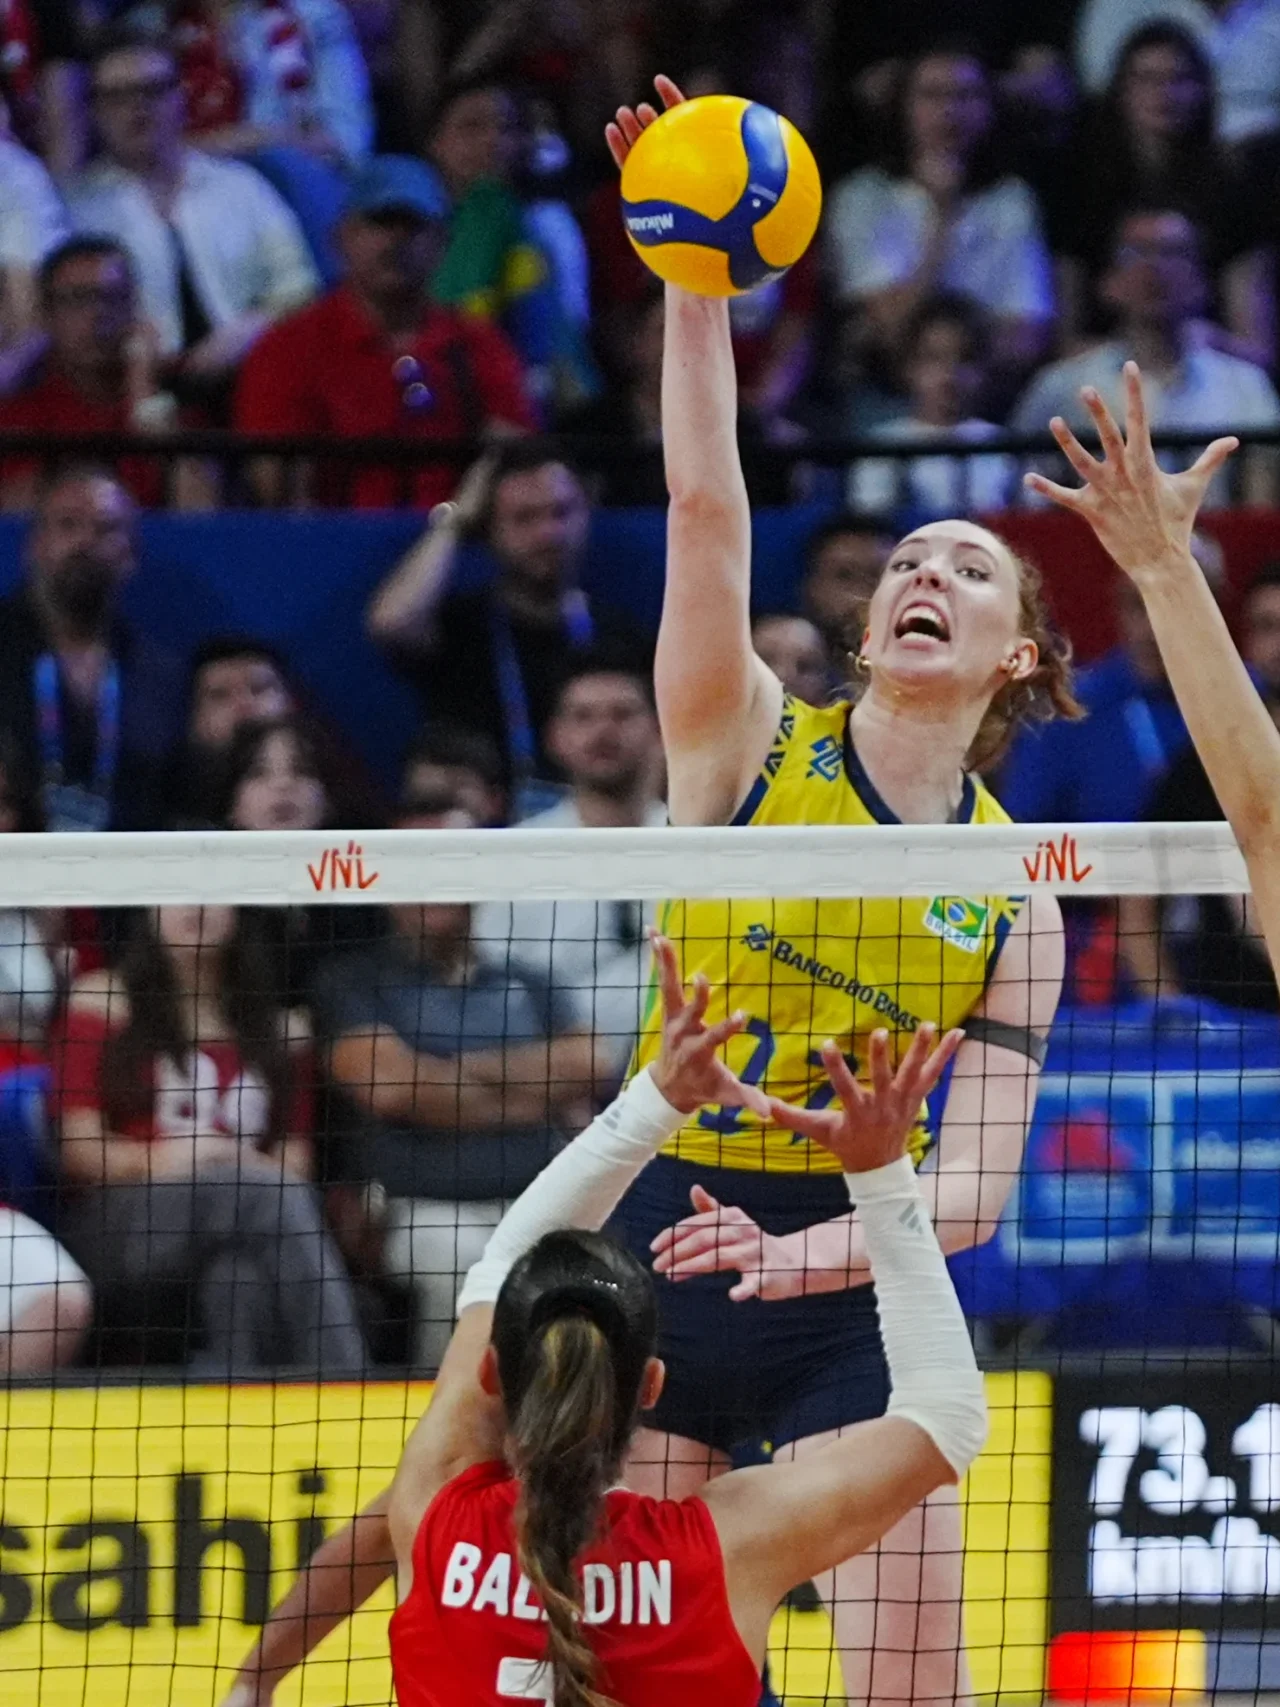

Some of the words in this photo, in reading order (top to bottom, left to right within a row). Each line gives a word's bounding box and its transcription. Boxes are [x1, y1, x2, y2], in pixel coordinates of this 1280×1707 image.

[307, 840, 378, 891] VNL
[1022, 832, 1092, 882] VNL
[773, 939, 846, 990] BANCO
[872, 991, 923, 1032] BRAS
[441, 1541, 671, 1625] BALDIN
